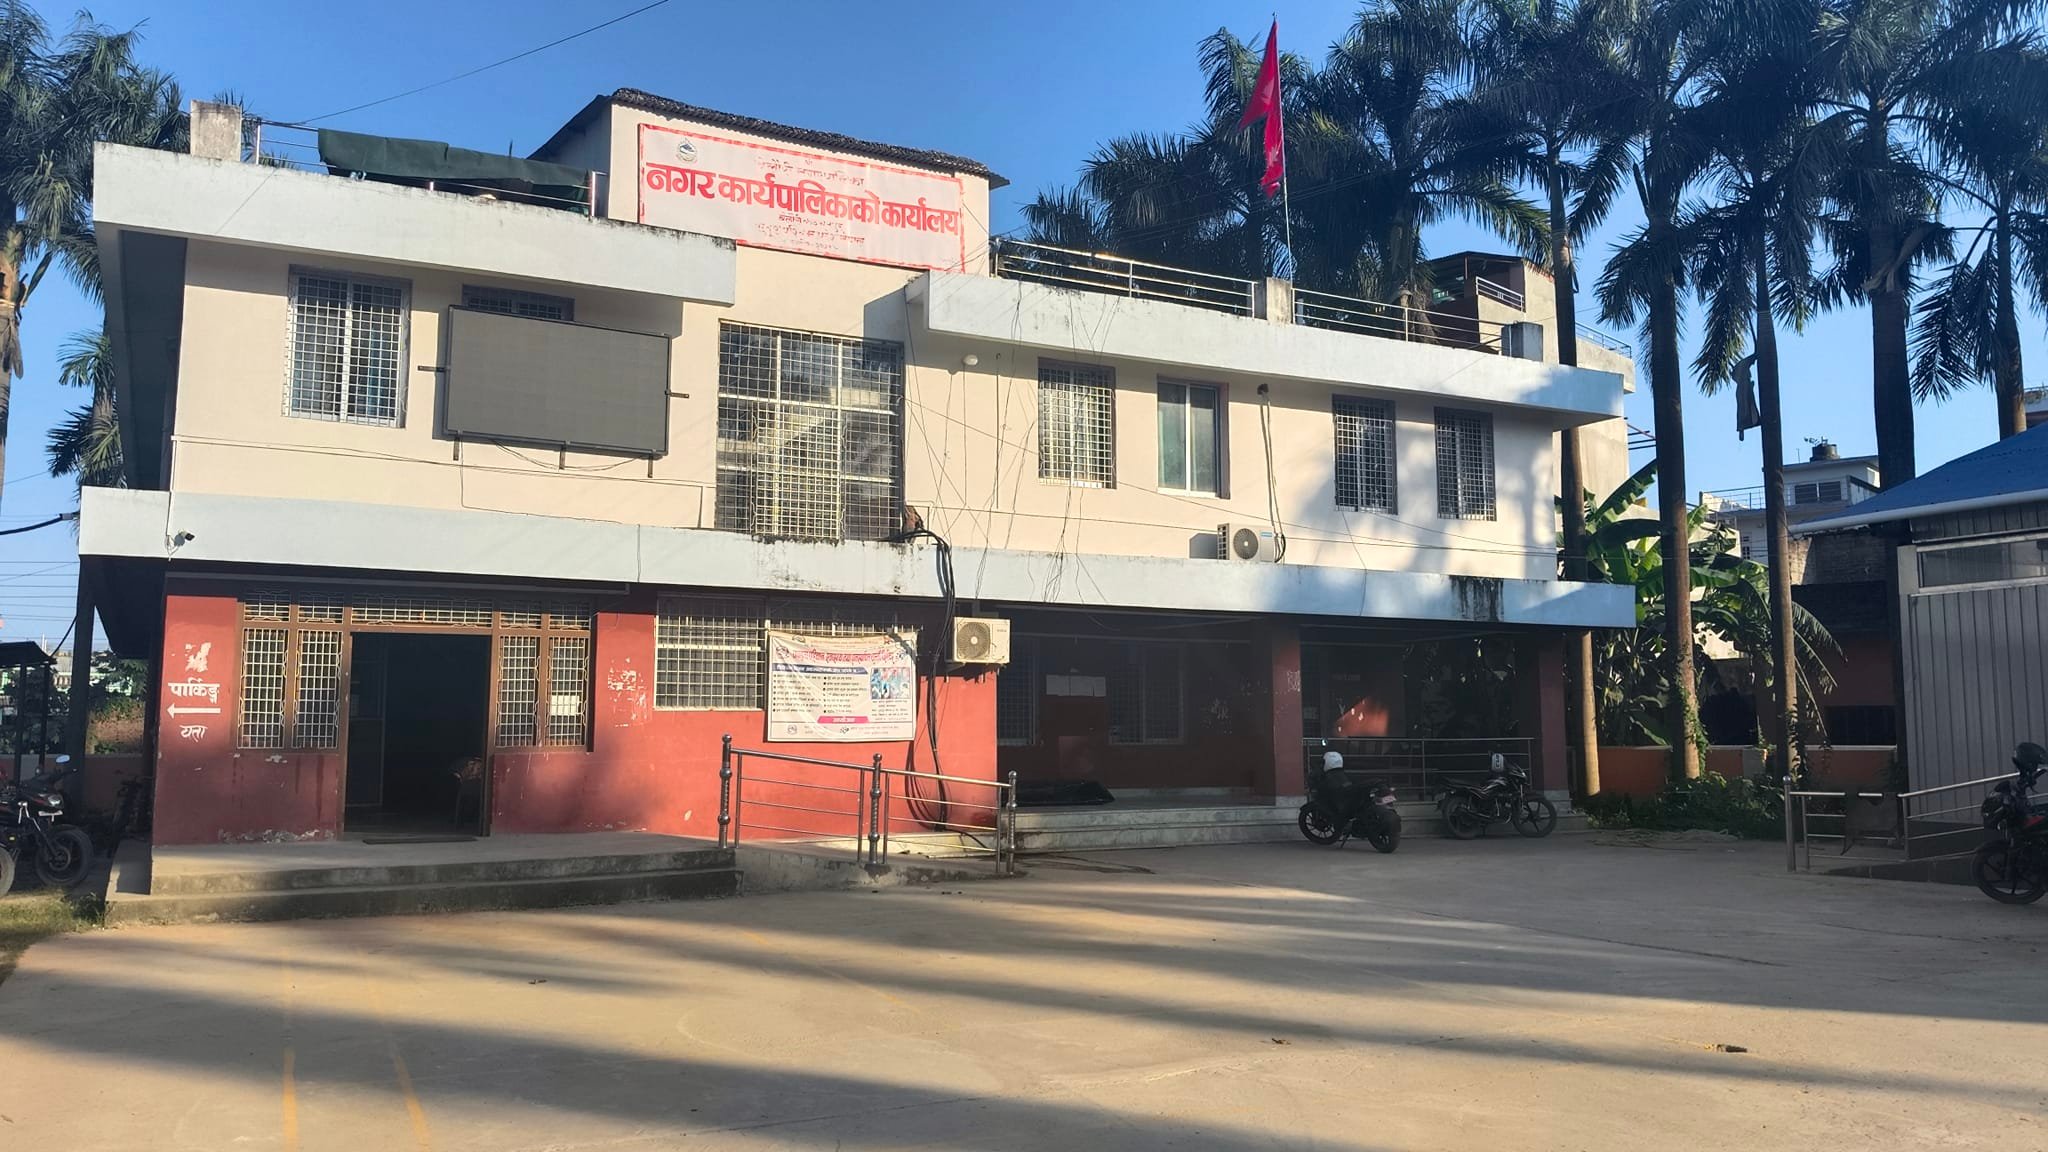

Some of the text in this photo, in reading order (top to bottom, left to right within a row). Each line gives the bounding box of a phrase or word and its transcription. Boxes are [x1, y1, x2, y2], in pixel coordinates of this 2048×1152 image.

[646, 162, 716, 199] नगर
[718, 172, 880, 225] कार्यपालिकाको
[881, 196, 960, 236] कार्यालय
[179, 724, 208, 743] यता
